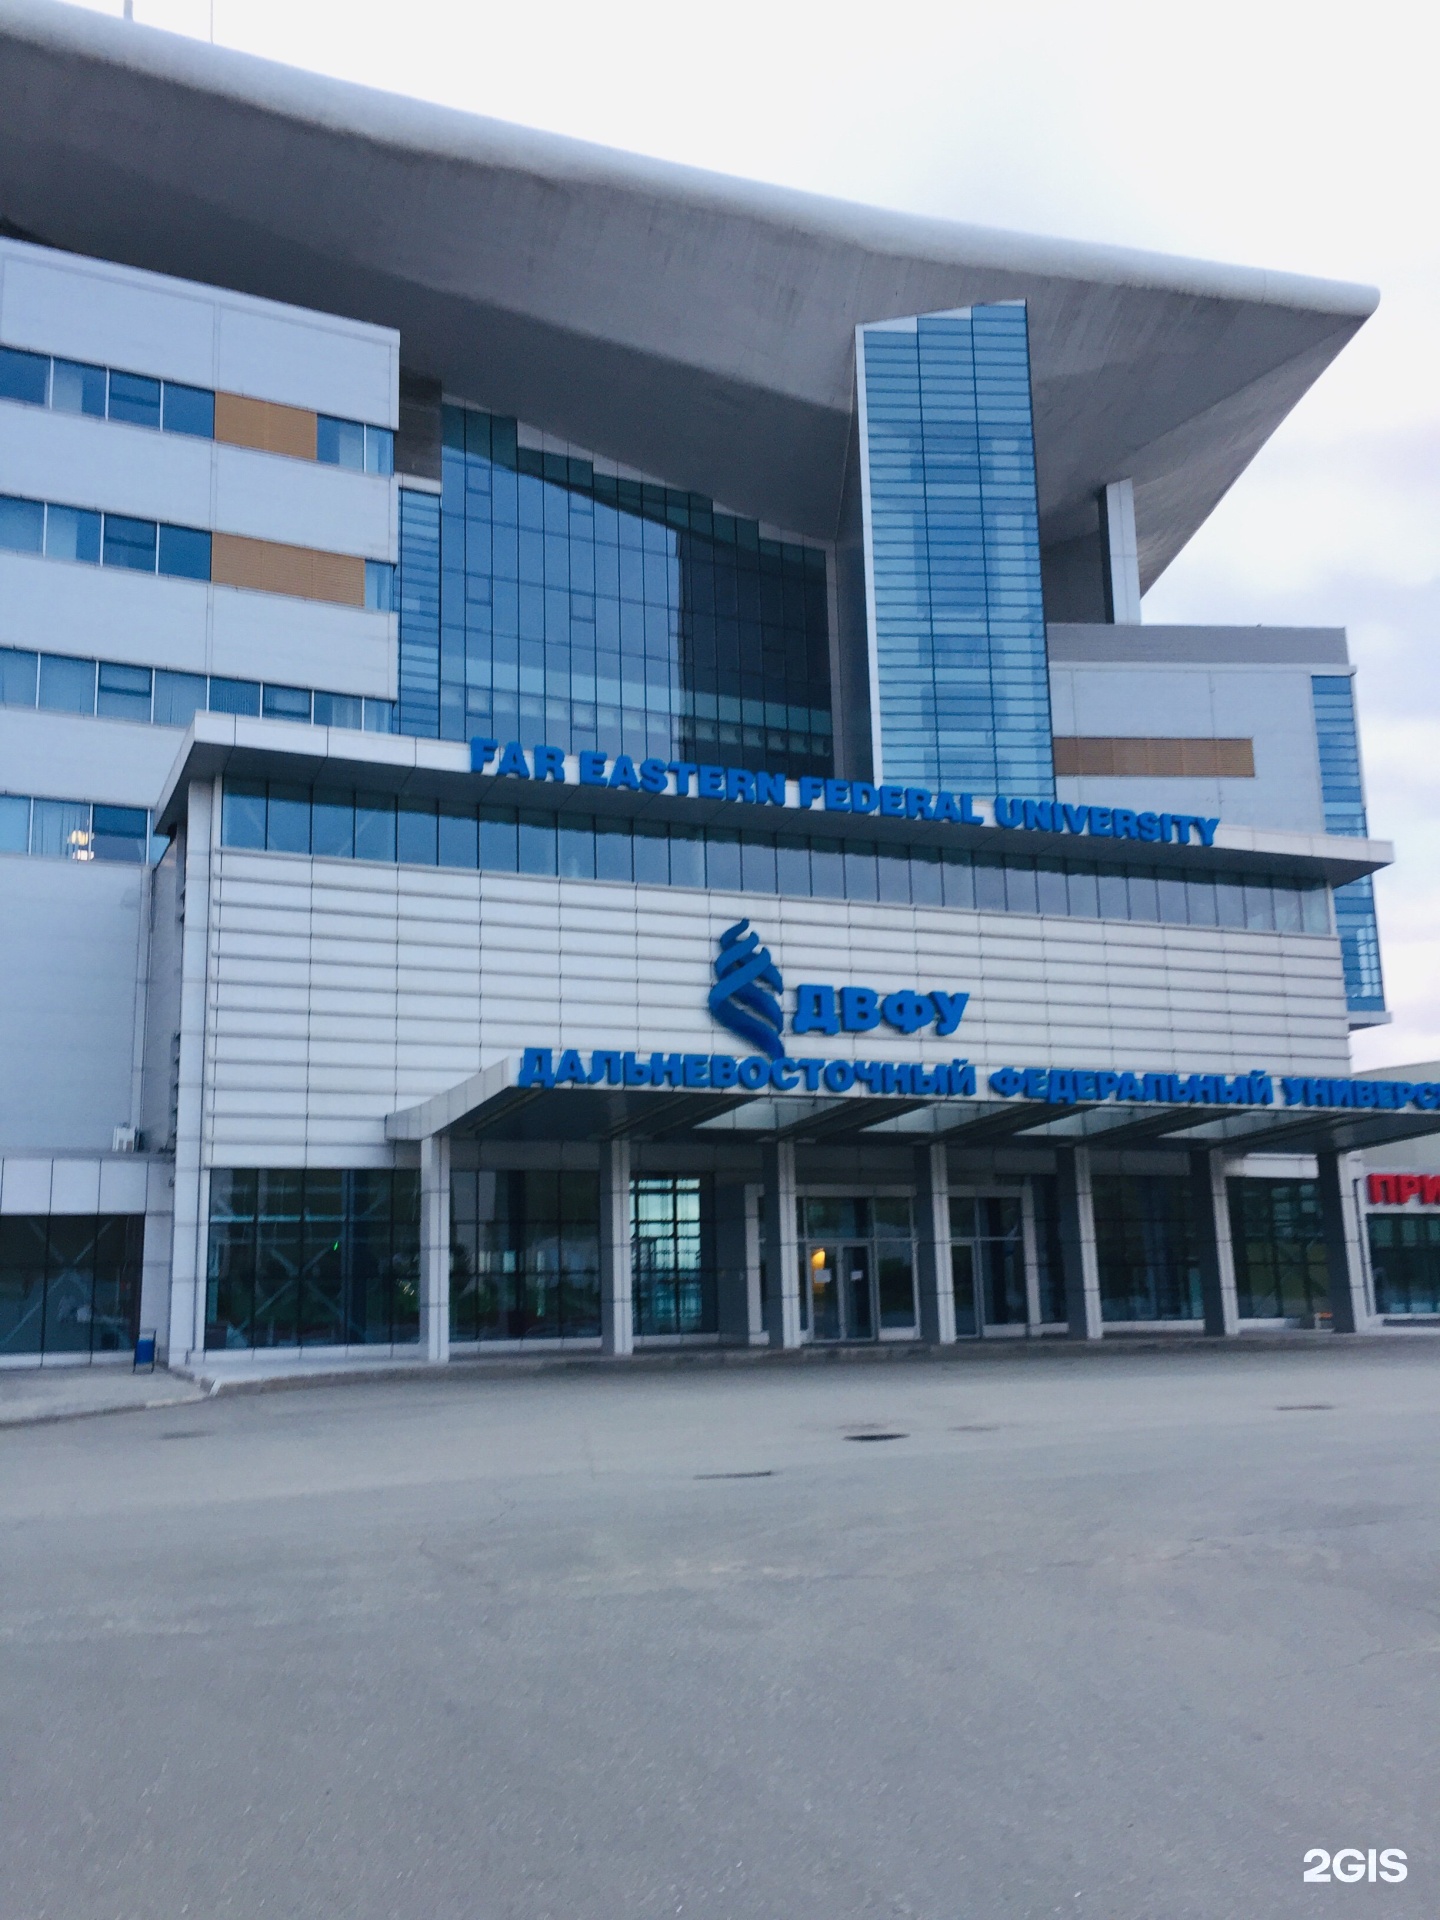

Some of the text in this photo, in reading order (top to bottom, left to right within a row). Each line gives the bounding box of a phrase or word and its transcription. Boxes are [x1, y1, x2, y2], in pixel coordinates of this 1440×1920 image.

[470, 736, 1221, 847] FAR EASTERN FEDERAL UNIVERSITY
[792, 984, 970, 1036] ДВФУ
[518, 1047, 1440, 1110] ДАЛЬНЕВОСТОЧНЫЙ ФЕДЕРАЛЬНЫЙ УНИВЕРС
